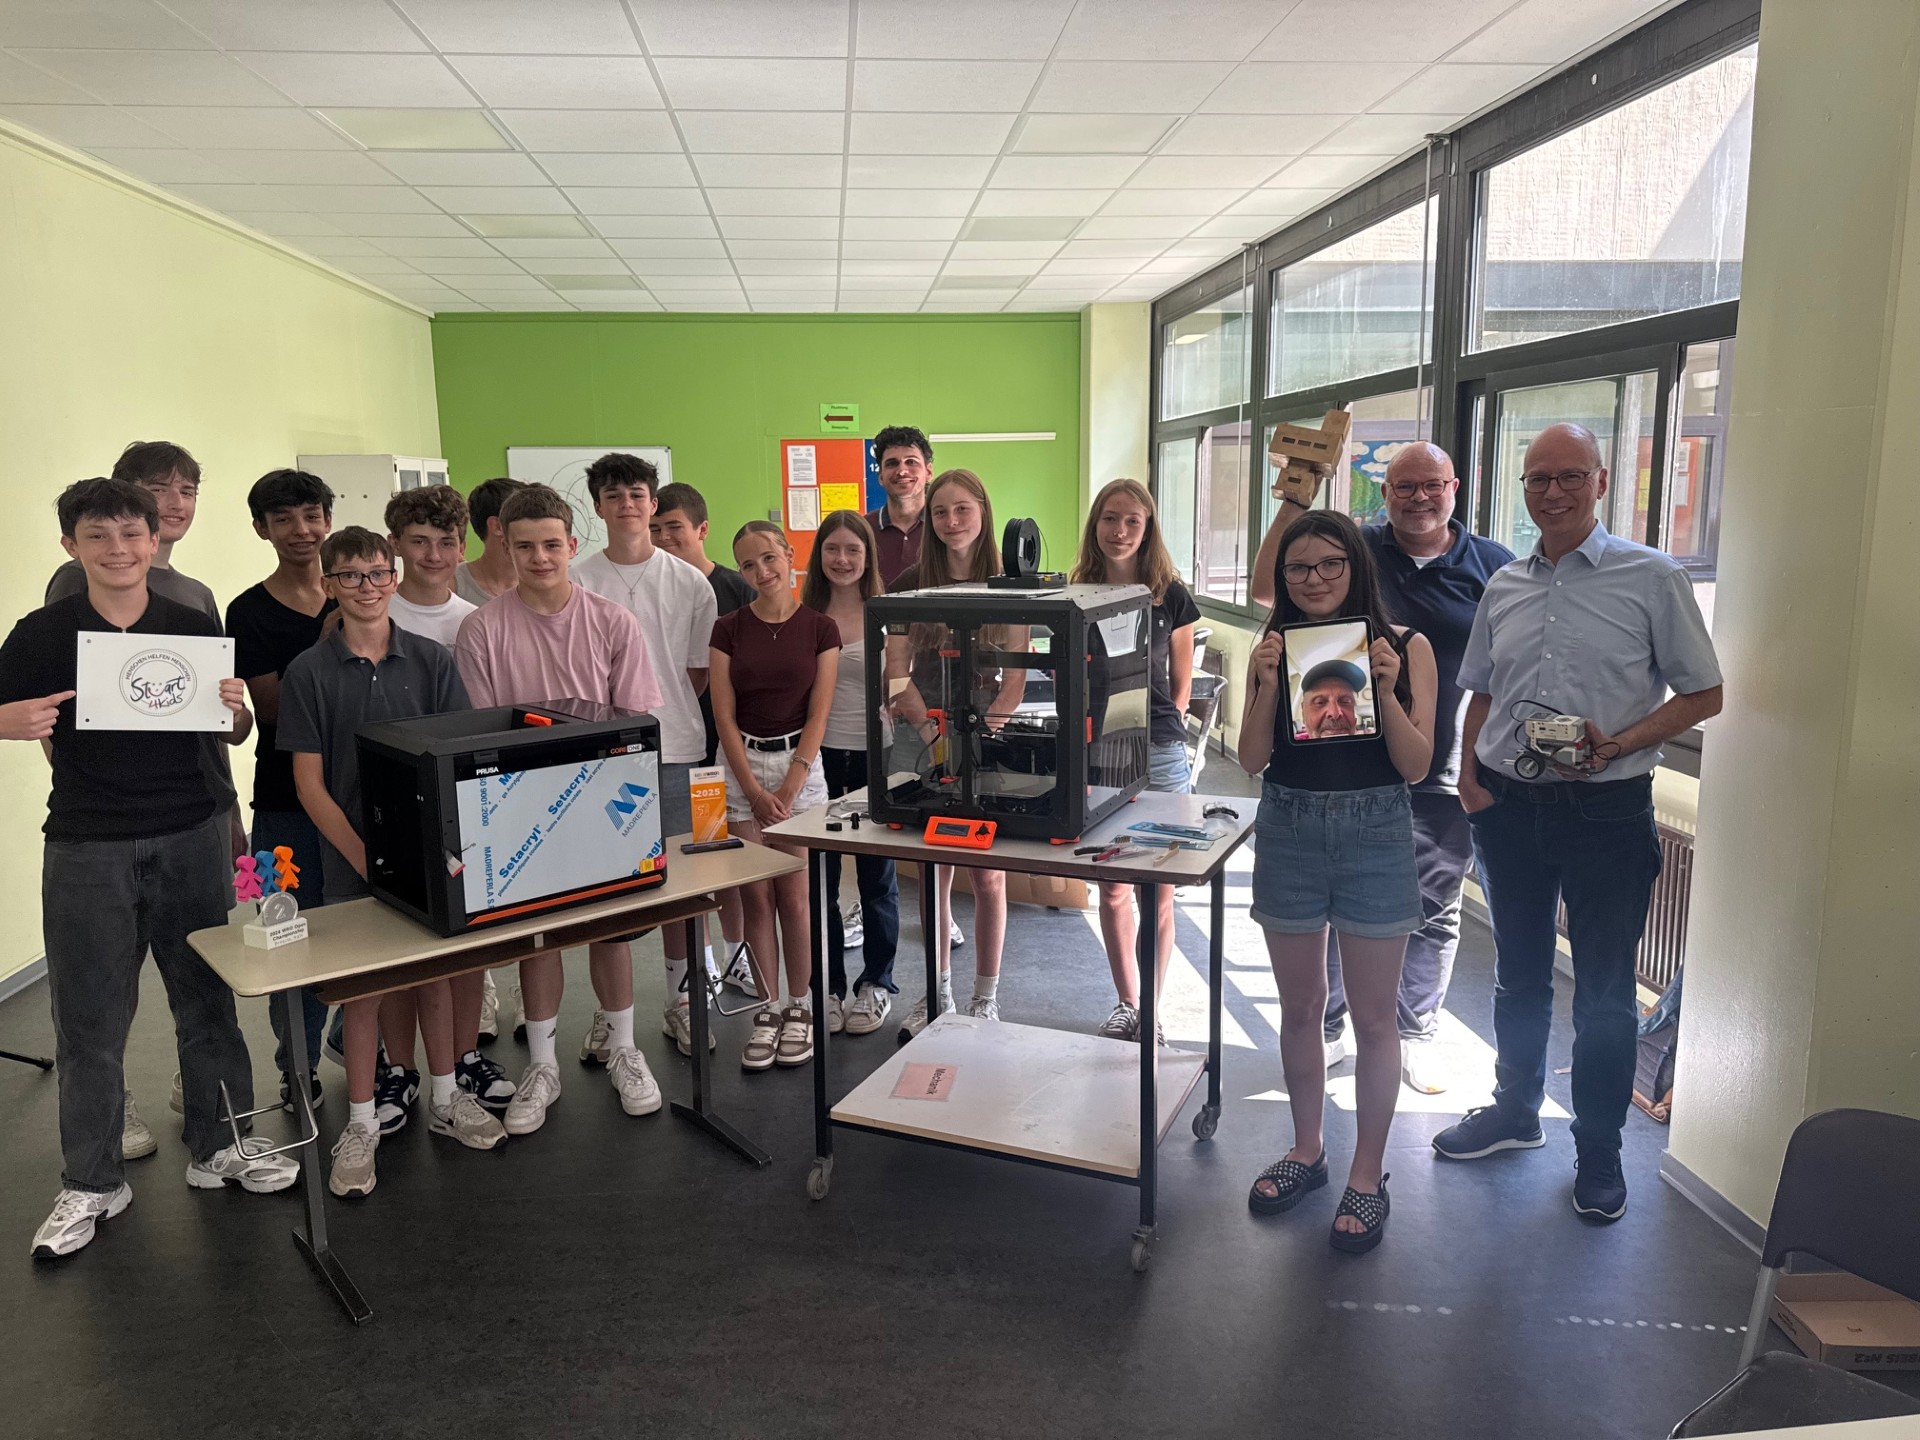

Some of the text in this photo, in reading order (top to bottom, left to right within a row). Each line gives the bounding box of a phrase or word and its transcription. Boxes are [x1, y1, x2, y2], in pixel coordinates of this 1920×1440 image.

[125, 653, 191, 682] MENSCHEN HELFEN MENSCHEN
[476, 766, 499, 776] PRUSA
[695, 788, 720, 798] 2025
[621, 792, 657, 838] MADREPERLA
[484, 846, 494, 898] MADREPERLA
[926, 1067, 947, 1095] Mechanik
